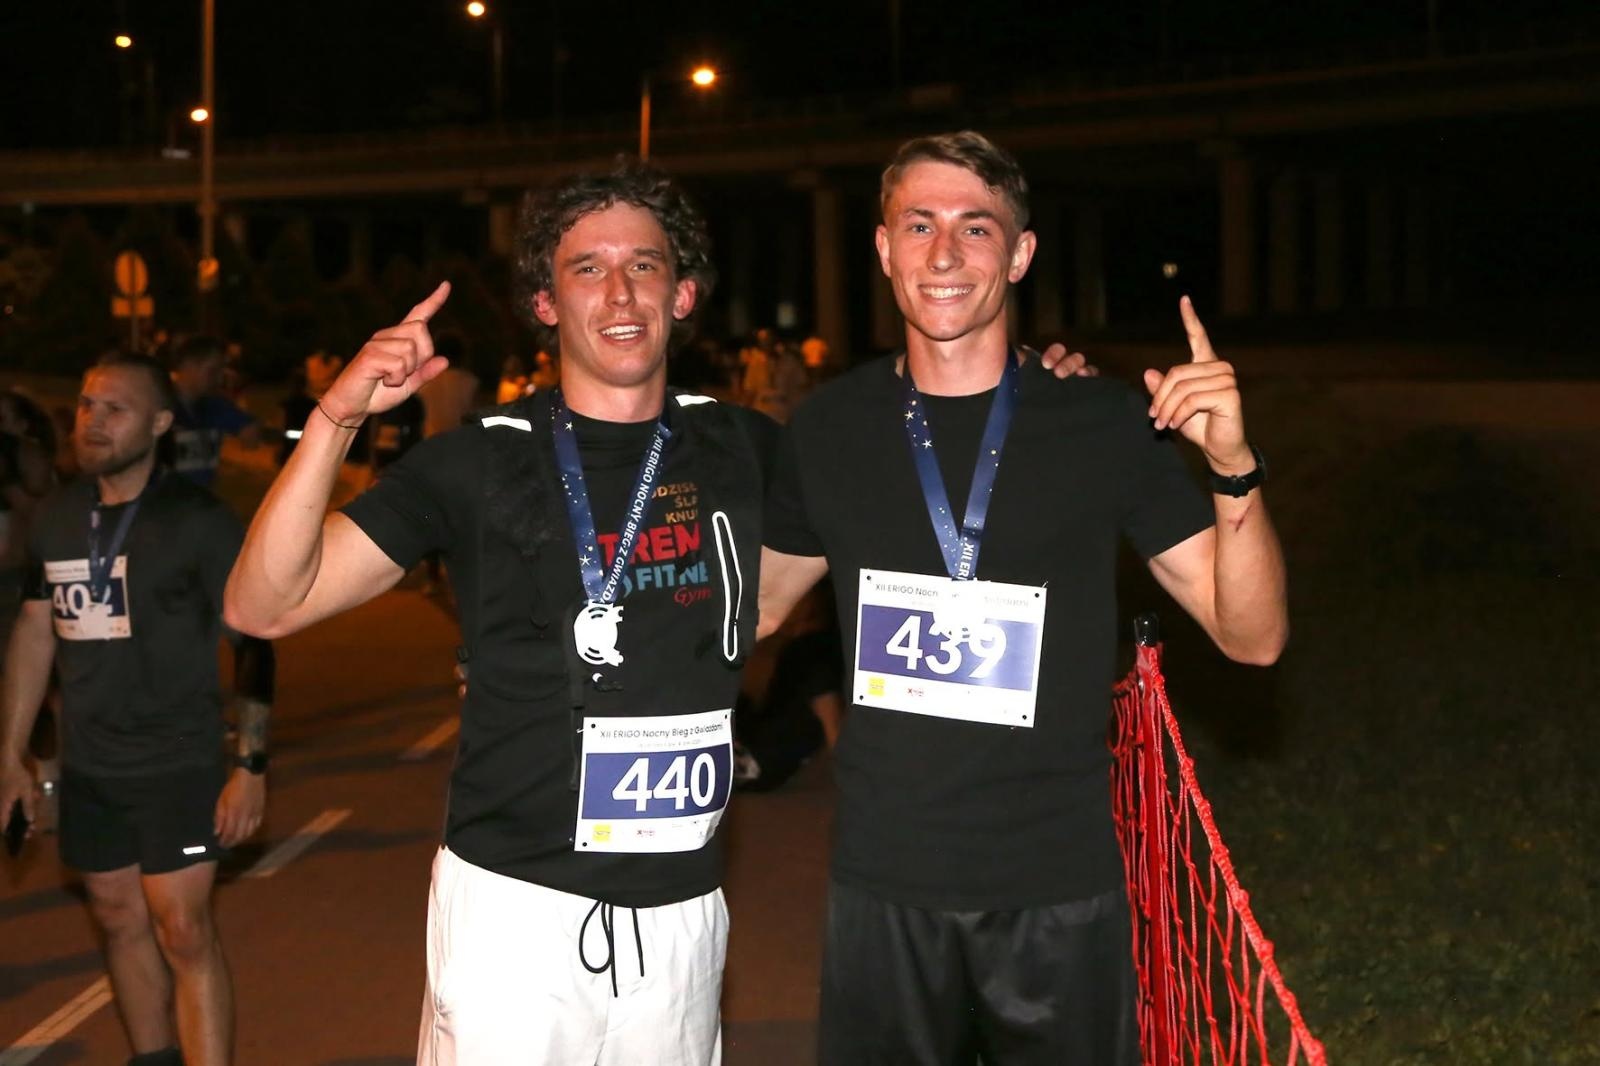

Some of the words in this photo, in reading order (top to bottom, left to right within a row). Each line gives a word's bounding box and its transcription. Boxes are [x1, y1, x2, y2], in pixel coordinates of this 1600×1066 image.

[653, 435, 664, 452] XII
[643, 450, 660, 483] ERIGO
[631, 483, 650, 522] NOCNY
[622, 521, 637, 547] BIEG
[619, 545, 629, 557] Z
[885, 615, 1007, 679] 439
[613, 729, 641, 738] ERIGO
[642, 729, 670, 738] Nocny
[672, 728, 689, 737] Bieg
[612, 752, 716, 812] 440
